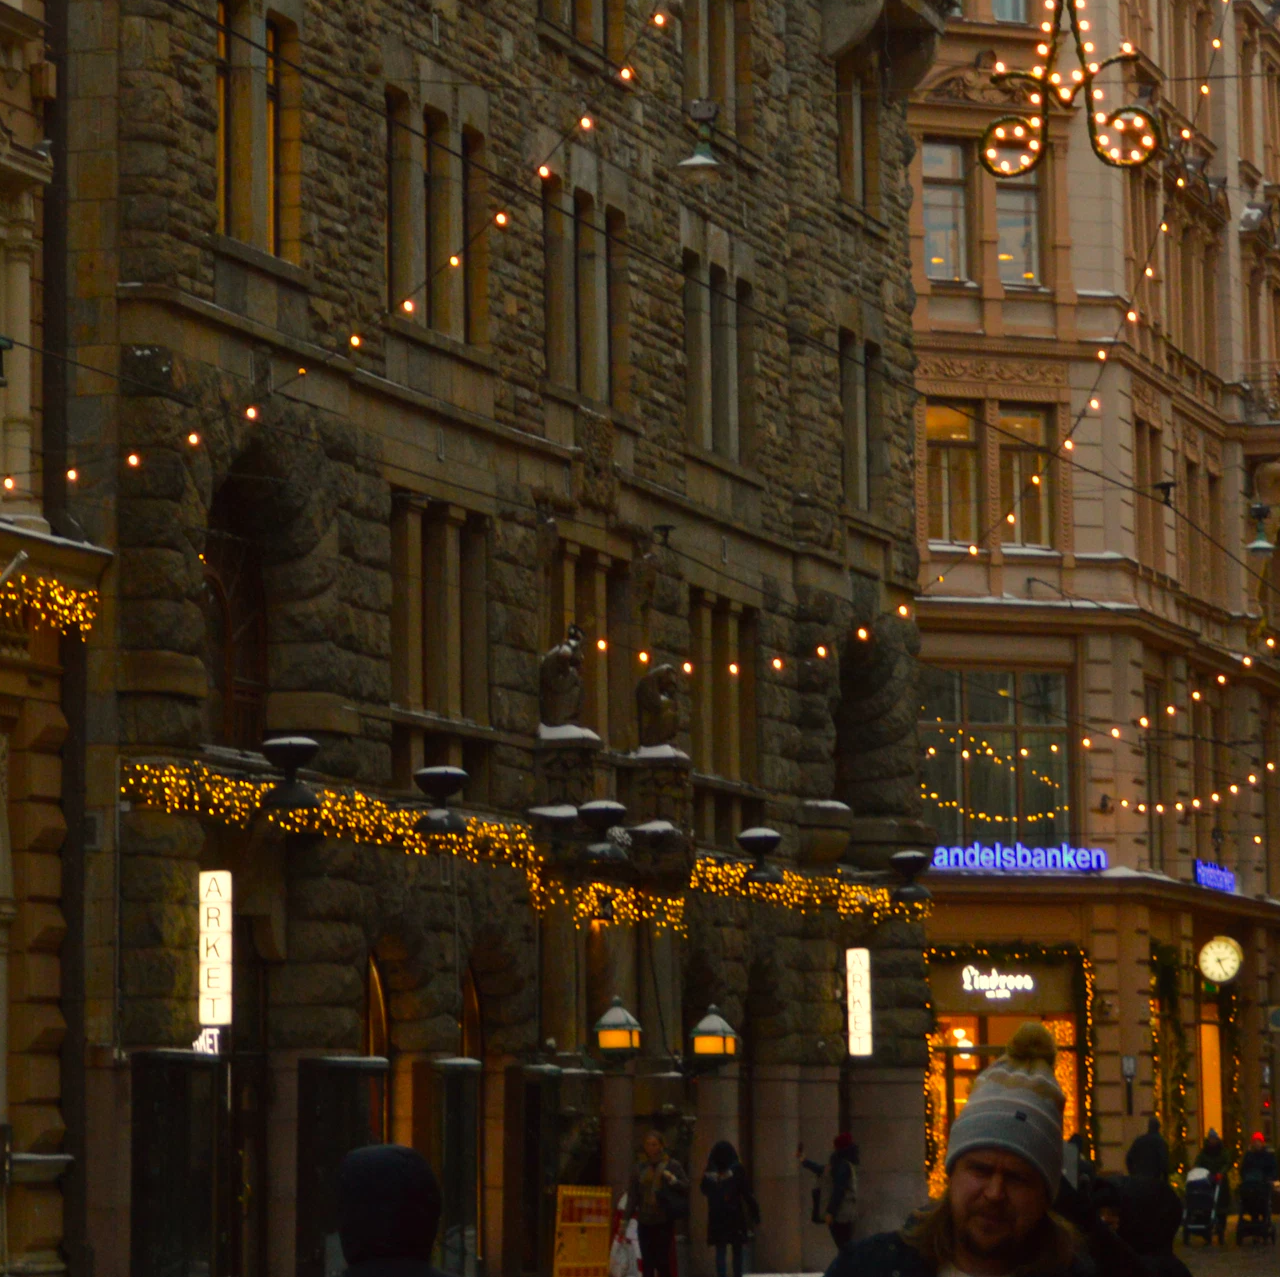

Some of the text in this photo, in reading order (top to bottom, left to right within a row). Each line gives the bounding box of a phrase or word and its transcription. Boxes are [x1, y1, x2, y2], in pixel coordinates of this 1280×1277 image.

[932, 841, 1108, 870] andelsbanken
[205, 877, 222, 1018] ARKET
[850, 952, 865, 1051] ARKET
